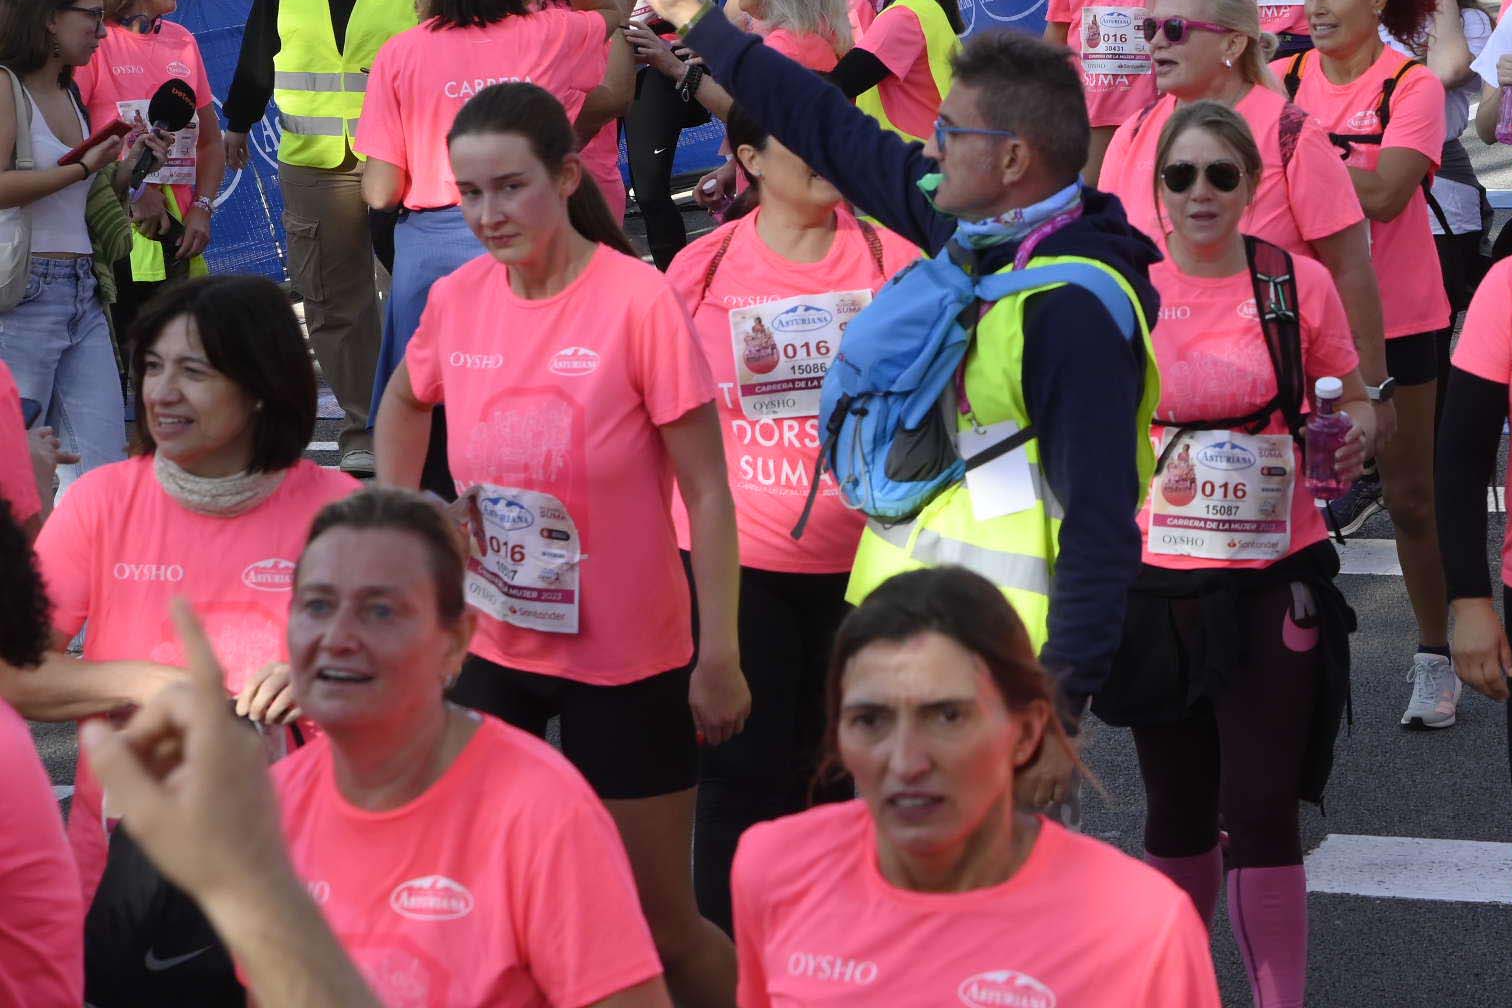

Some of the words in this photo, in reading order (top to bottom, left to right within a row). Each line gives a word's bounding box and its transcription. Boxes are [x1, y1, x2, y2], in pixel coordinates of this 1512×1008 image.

[1102, 33, 1128, 44] 016
[776, 314, 830, 330] ASTURIANA
[783, 339, 831, 360] 016
[449, 350, 504, 369] OYSHO
[790, 362, 828, 376] 15086
[754, 380, 794, 393] CARRERA
[795, 379, 806, 389] DE
[807, 378, 820, 389] LA
[753, 397, 796, 412] OYSHO
[1202, 451, 1252, 465] ASTURIANA
[1201, 479, 1248, 500] 016
[1205, 504, 1240, 517] 15087
[1167, 517, 1205, 529] CARRERA
[1206, 520, 1218, 530] DE
[1219, 521, 1230, 530] LA
[488, 534, 526, 564] 016
[1162, 534, 1205, 547] OYSHO
[1237, 538, 1280, 549] Santander
[113, 562, 184, 583] OYSHO
[248, 569, 295, 584] ASTURIA
[518, 607, 567, 621] Santander
[399, 889, 467, 911] ASTURIANA
[786, 950, 879, 986] OYSHO
